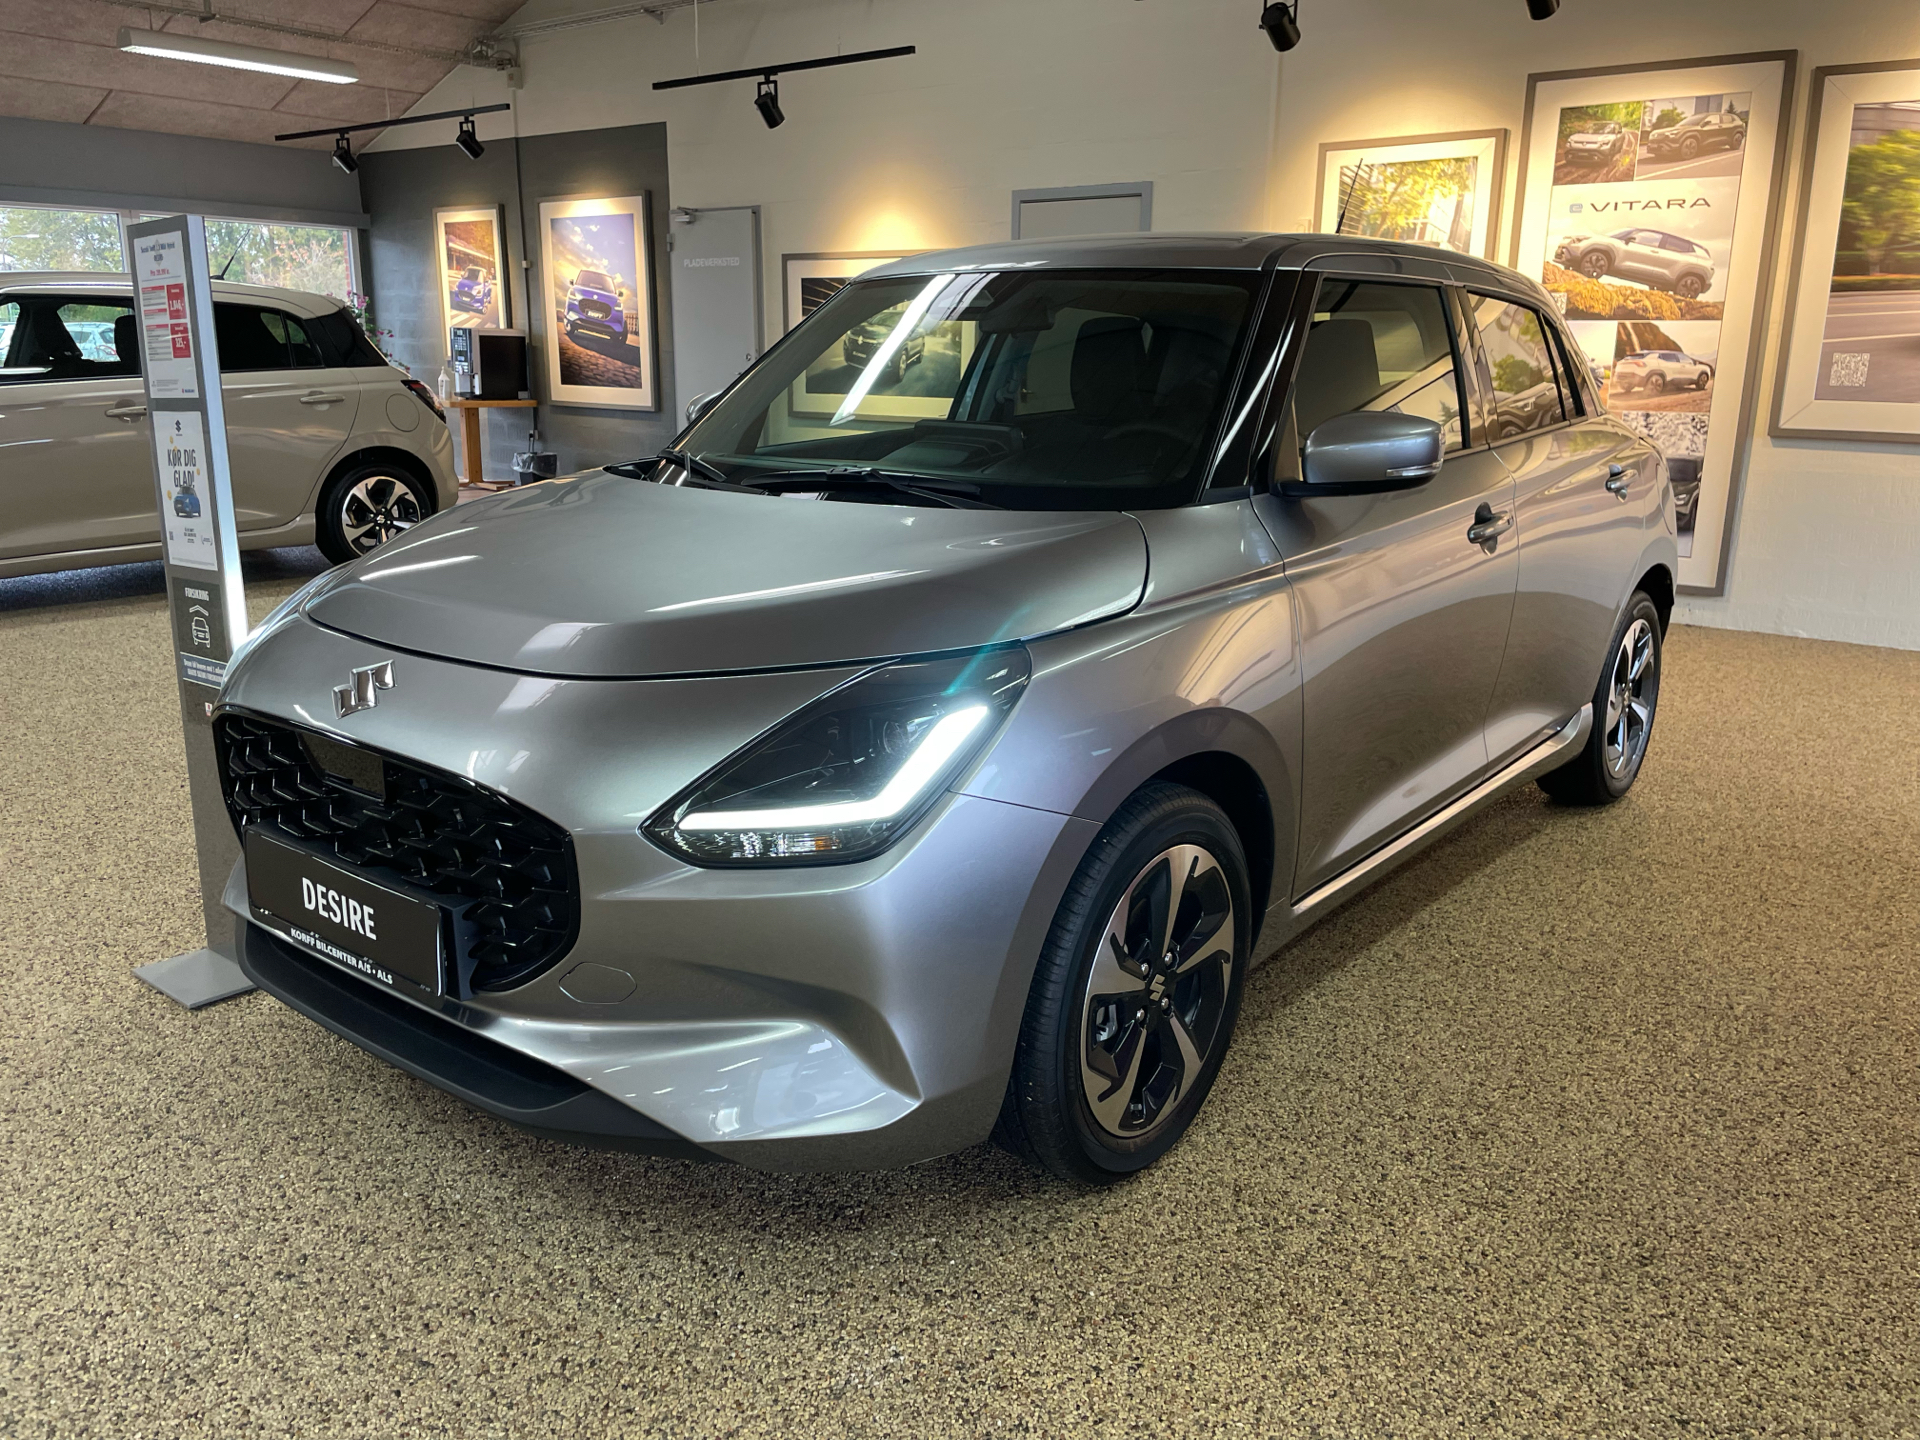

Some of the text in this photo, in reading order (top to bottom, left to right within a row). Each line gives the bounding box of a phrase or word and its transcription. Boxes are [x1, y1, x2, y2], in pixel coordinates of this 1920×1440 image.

[1590, 197, 1711, 212] VITARA
[167, 449, 196, 468] KØR DIG
[174, 470, 195, 488] GLAD!
[302, 877, 377, 941] DESIRE
[290, 928, 393, 985] KORFF BILCENTER A/S ALS
